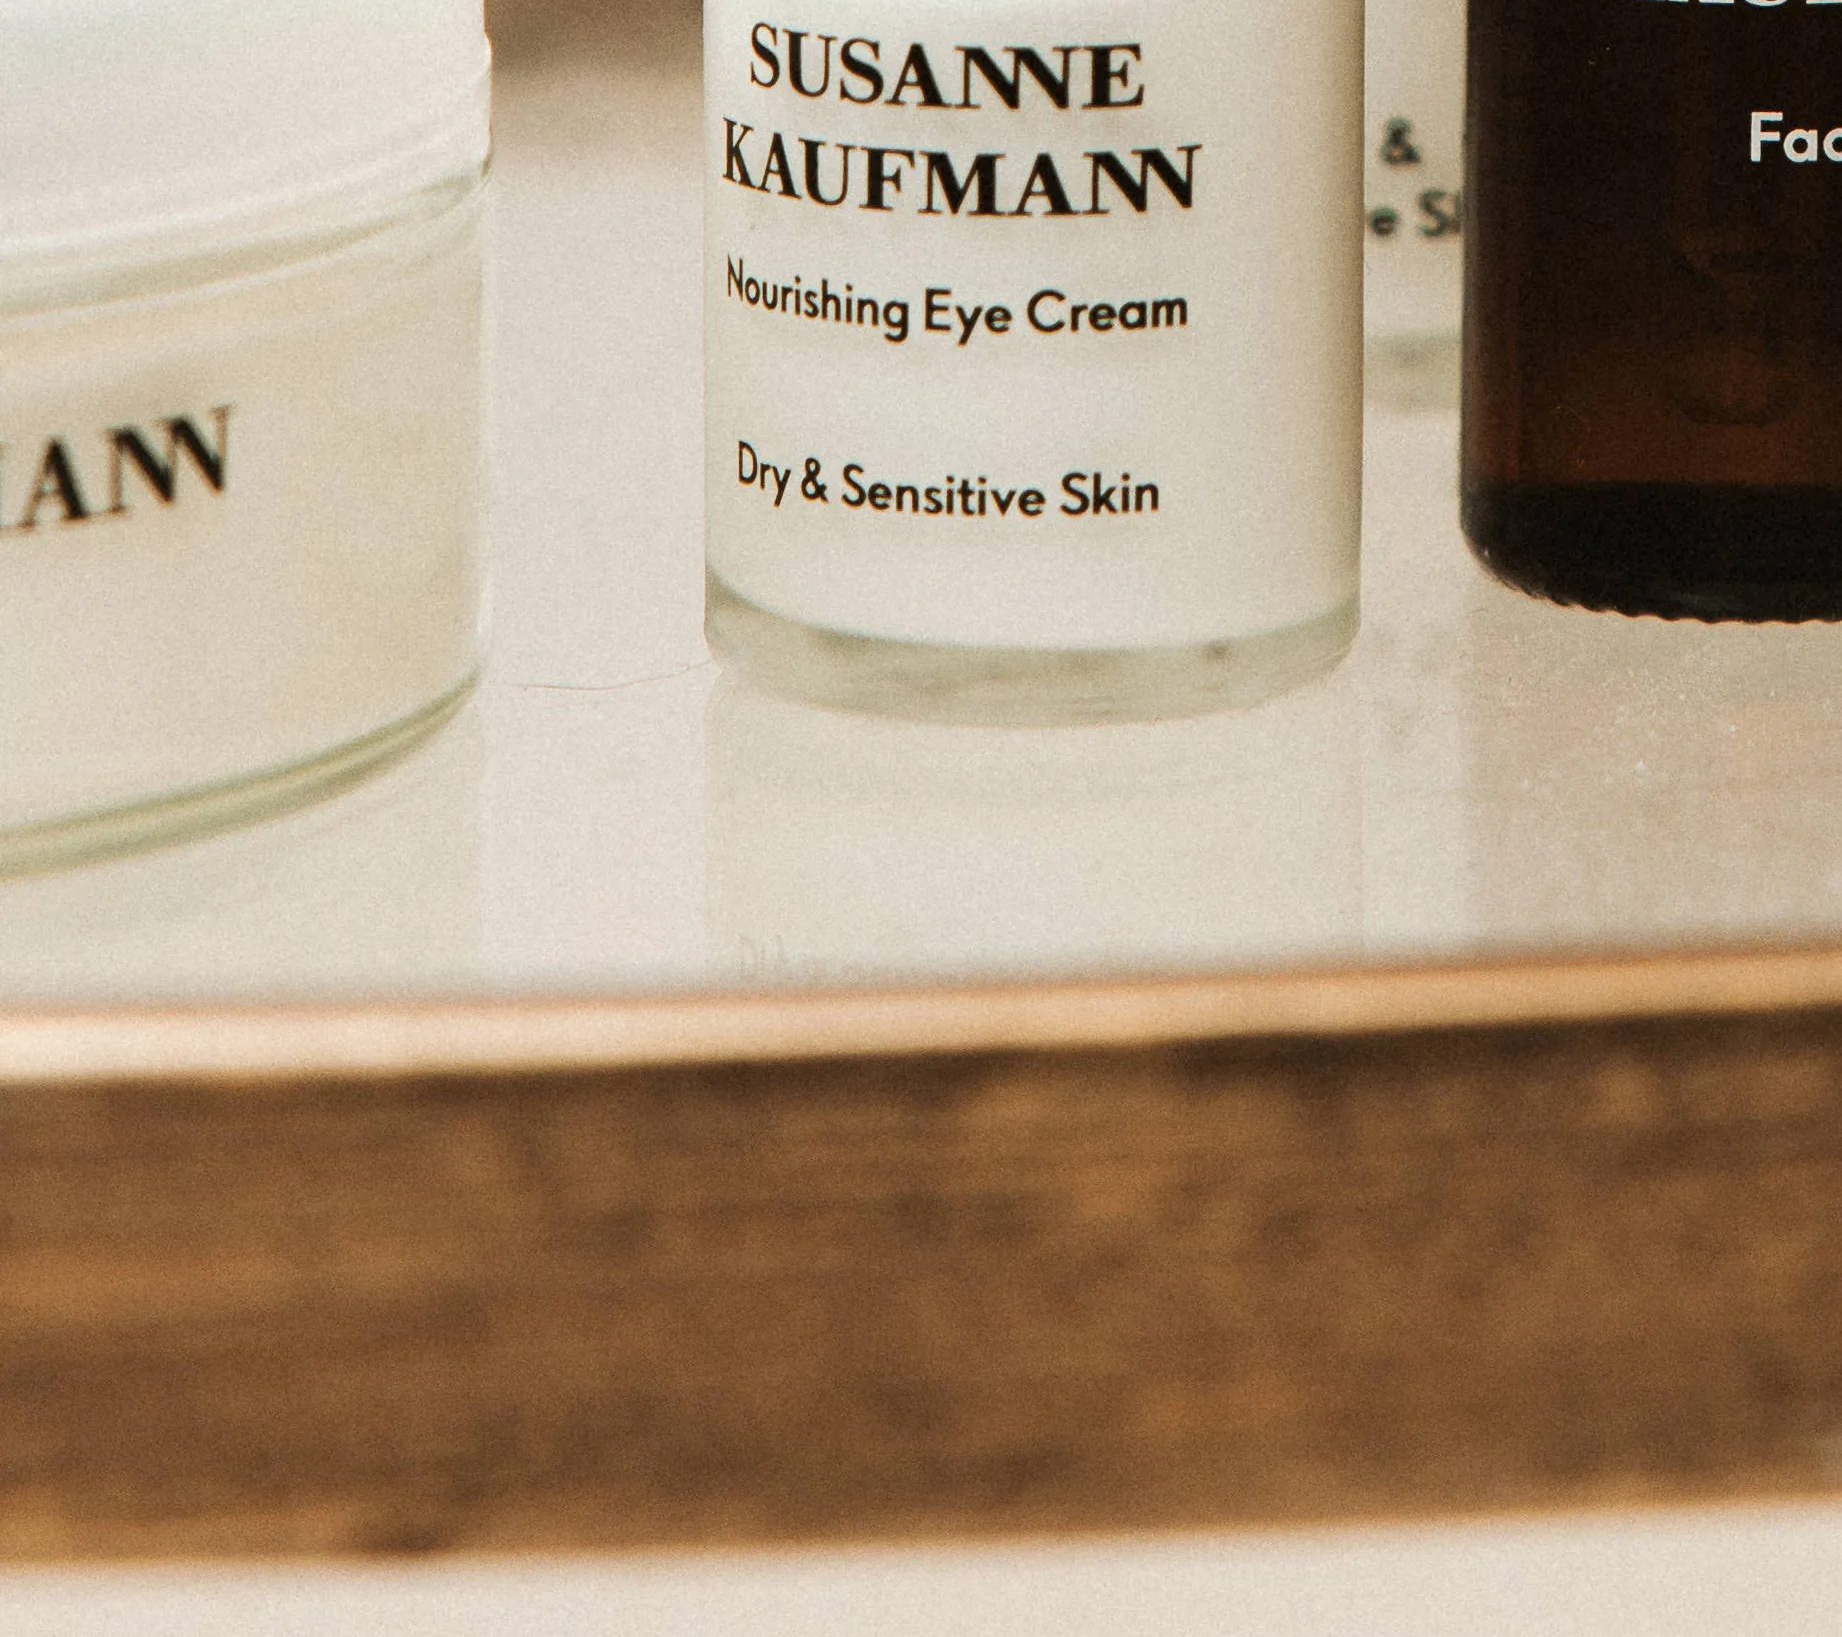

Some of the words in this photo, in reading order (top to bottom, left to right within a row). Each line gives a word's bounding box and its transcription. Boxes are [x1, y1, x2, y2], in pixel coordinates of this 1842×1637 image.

[749, 21, 1145, 111] SUSANNE
[722, 116, 1203, 218] KAUFMANN
[726, 252, 909, 343] Nourishing
[924, 288, 1013, 347] Eye
[1026, 289, 1188, 334] Cream
[0, 404, 233, 536] ANN
[738, 440, 792, 507] Dry
[800, 457, 829, 503] &
[841, 463, 1046, 517] Sensitive
[1060, 472, 1160, 517] Skin
